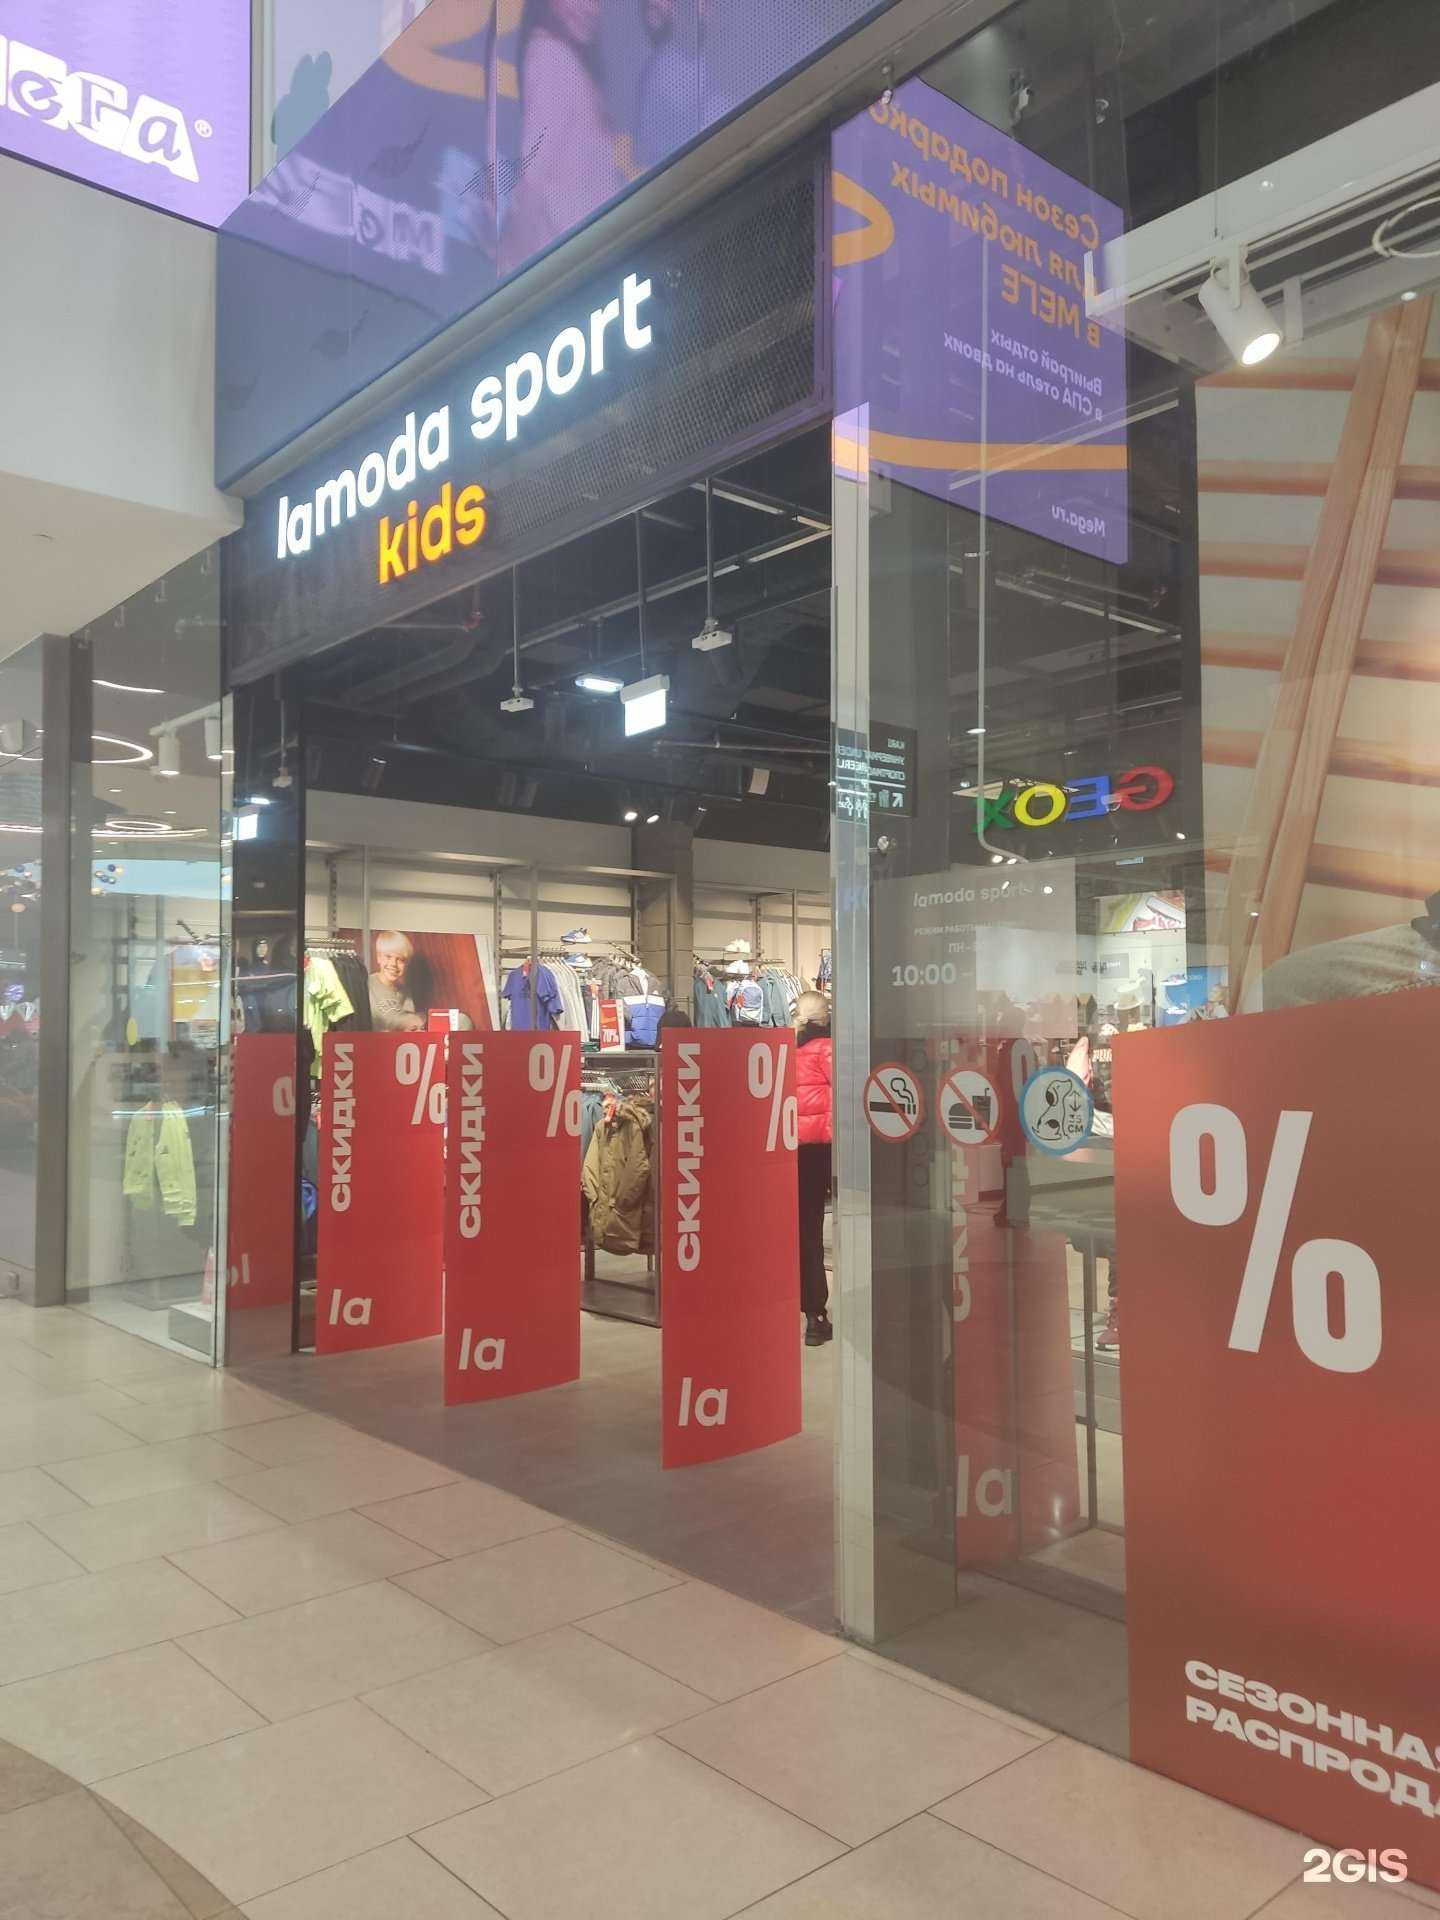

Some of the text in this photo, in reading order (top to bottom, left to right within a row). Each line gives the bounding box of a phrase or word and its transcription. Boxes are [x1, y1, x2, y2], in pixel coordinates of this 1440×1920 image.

[277, 272, 653, 560] lamoda sport
[379, 481, 488, 584] kids
[913, 888, 975, 908] lamoda
[892, 962, 957, 987] 10:00
[332, 1043, 356, 1212] СКИДКИ
[460, 1043, 485, 1238] СКИДКИ
[678, 1043, 704, 1272] СКИДКИ
[1168, 1102, 1383, 1374] %
[329, 1289, 373, 1325] la
[458, 1328, 505, 1371] la
[678, 1377, 728, 1427] la
[956, 1455, 1013, 1517] la
[1185, 1660, 1440, 1772] СЕЗОННА
[1186, 1695, 1440, 1818] РАСПРОД
